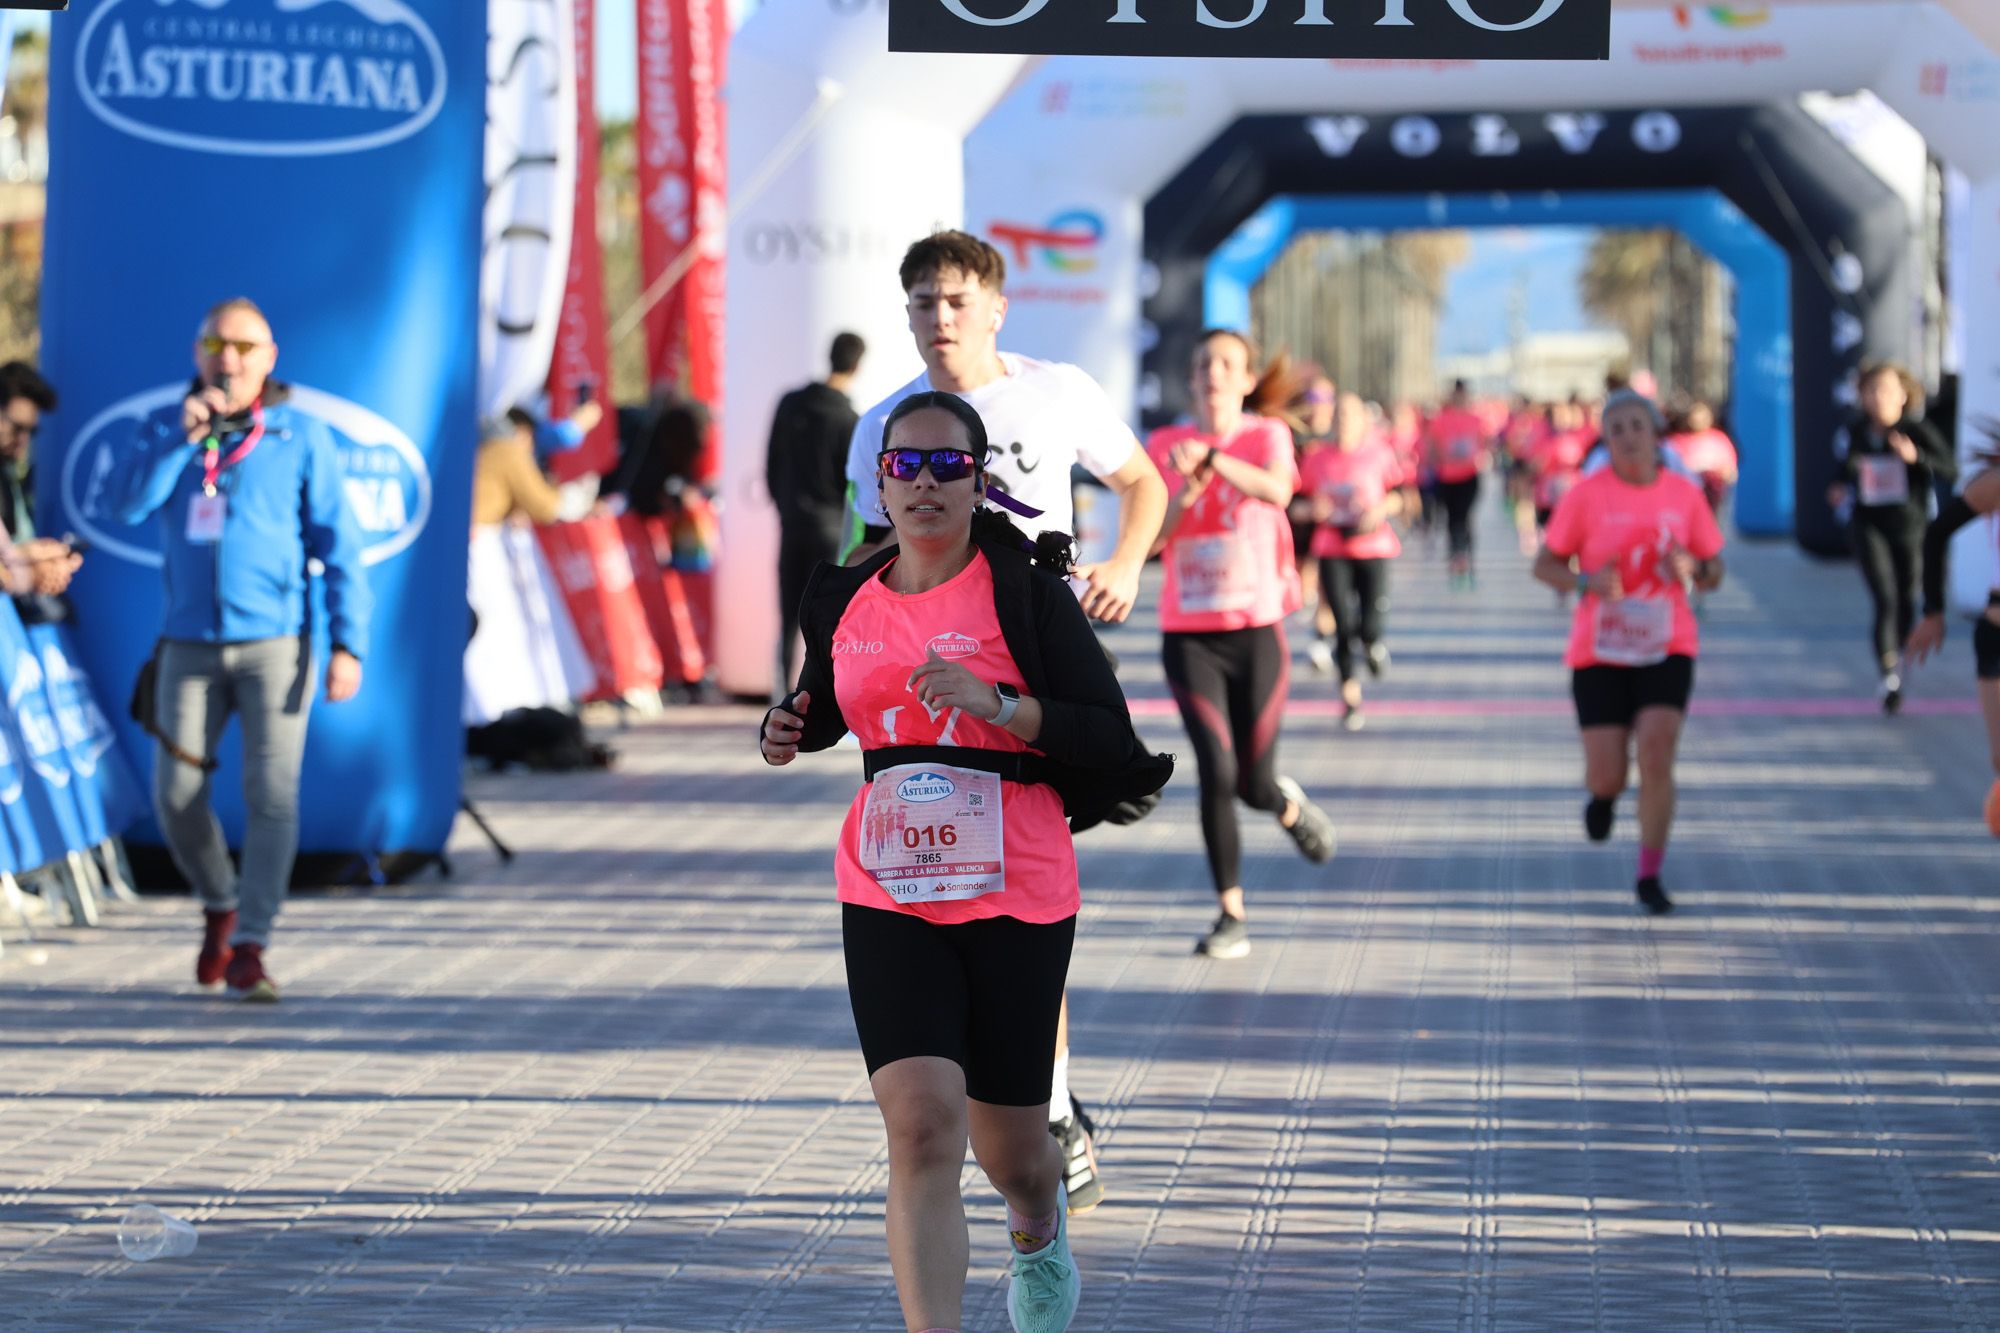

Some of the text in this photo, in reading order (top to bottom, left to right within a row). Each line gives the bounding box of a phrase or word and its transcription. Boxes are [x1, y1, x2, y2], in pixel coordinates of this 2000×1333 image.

[96, 17, 424, 112] ASTURIANA
[1306, 112, 1682, 157] VOLVO
[834, 641, 884, 655] OYSHO
[901, 786, 950, 797] ASTURIANA
[903, 825, 957, 848] 016
[914, 852, 942, 864] 7865
[876, 864, 985, 879] CARRERA DE LA MUJER VALENCIA
[946, 881, 988, 892] Santander
